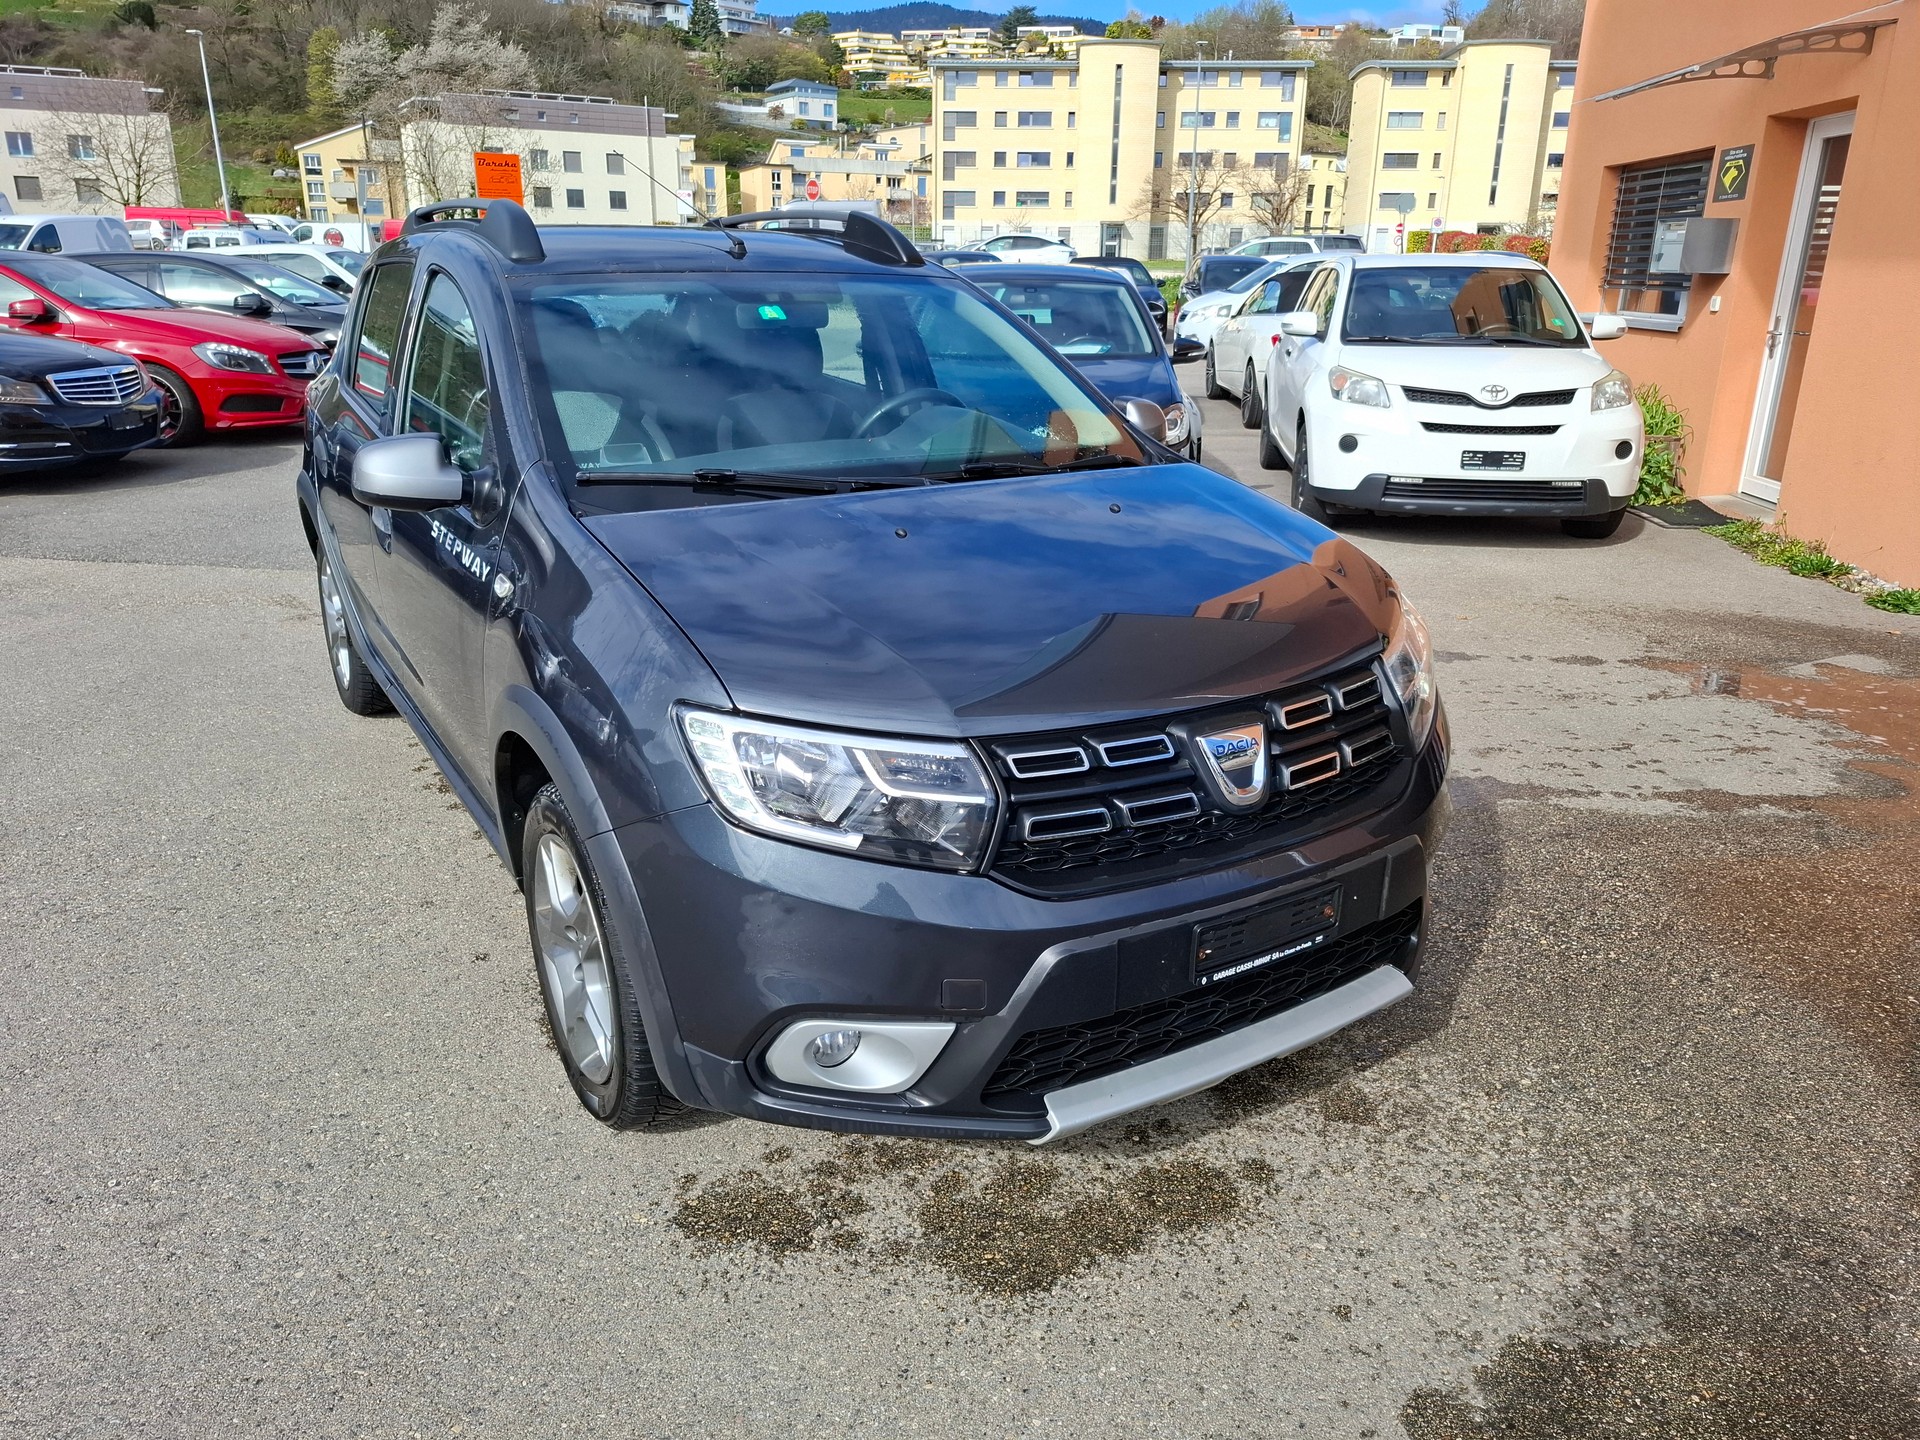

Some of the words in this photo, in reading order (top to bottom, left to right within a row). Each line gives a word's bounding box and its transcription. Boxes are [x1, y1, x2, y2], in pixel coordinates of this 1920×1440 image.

[477, 158, 517, 168] Baraka
[807, 186, 819, 194] STOP
[431, 520, 491, 582] STEPWAY
[1216, 737, 1259, 756] DACIA
[1213, 966, 1236, 981] GARAGE
[1272, 951, 1280, 960] SA
